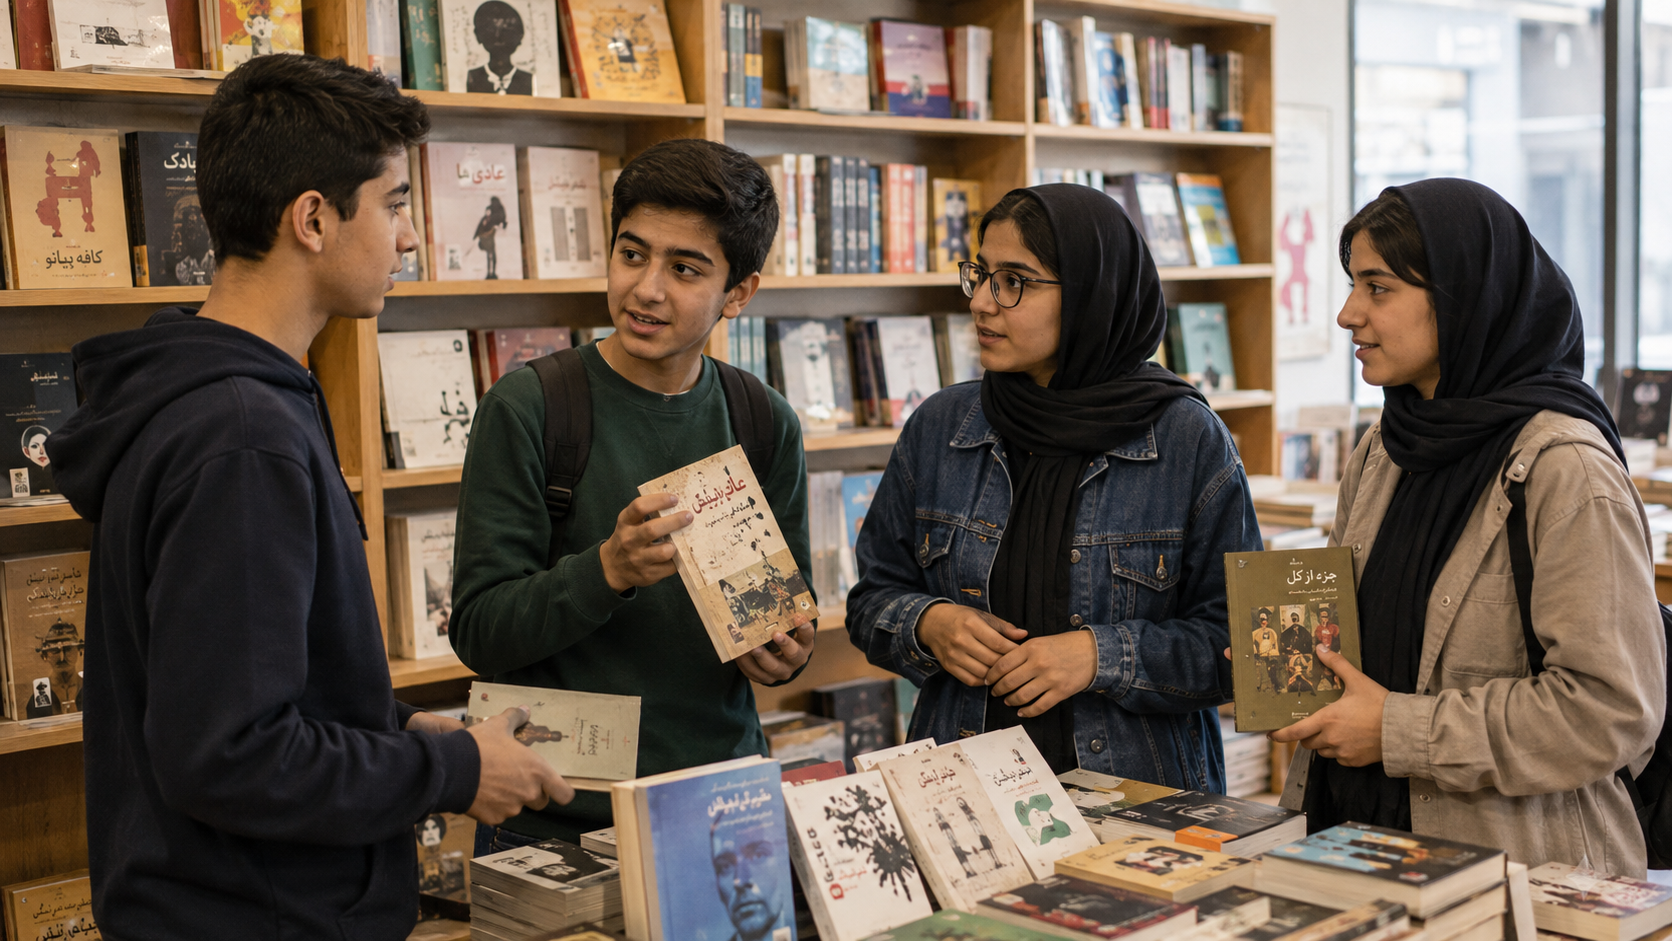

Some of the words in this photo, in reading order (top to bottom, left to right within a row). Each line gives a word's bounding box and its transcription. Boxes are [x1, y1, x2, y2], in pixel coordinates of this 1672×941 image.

[45, 249, 74, 269] پیانو
[76, 249, 103, 264] کافه
[1287, 569, 1304, 585] کل
[1304, 569, 1314, 585] از
